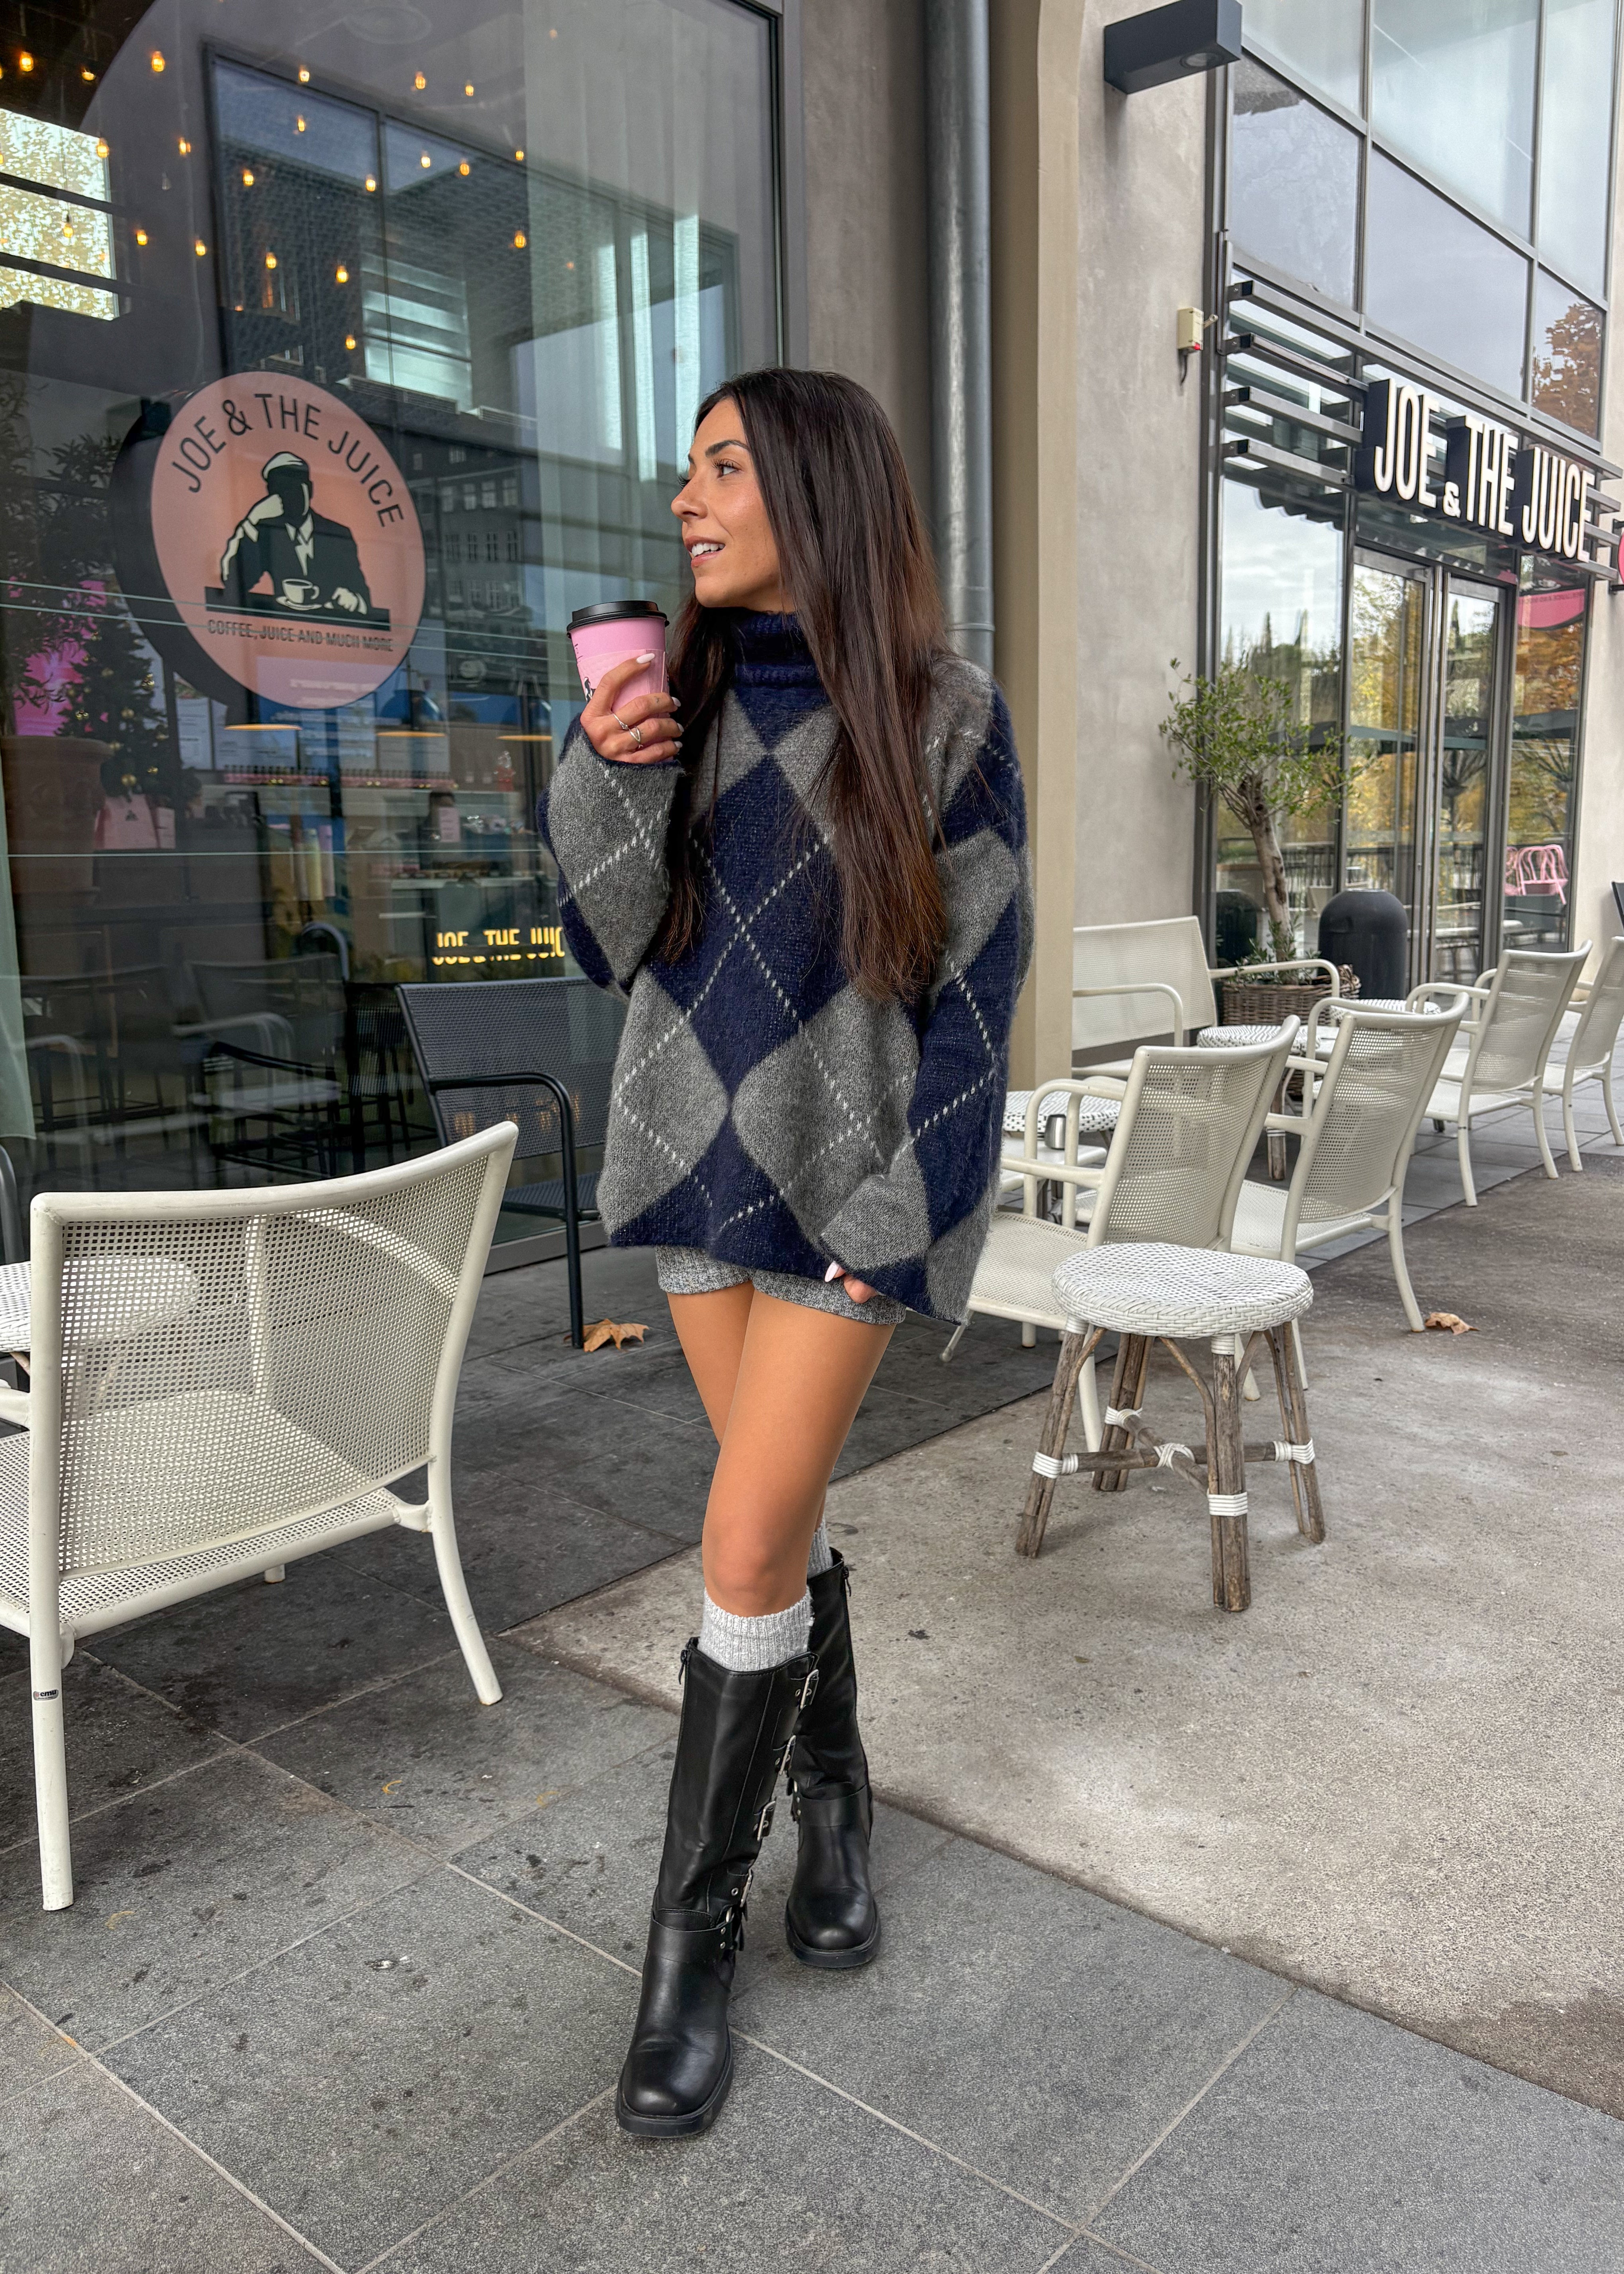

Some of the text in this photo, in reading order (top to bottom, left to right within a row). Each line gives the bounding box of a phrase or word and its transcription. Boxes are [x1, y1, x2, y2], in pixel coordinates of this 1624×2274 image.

[172, 393, 405, 528] JOE & THE JUICE
[1374, 378, 1595, 563] JOE & THE JUICE
[260, 625, 295, 642] JUICE
[297, 629, 323, 645] AND
[326, 632, 360, 649] MUCH
[362, 636, 394, 652] MORE
